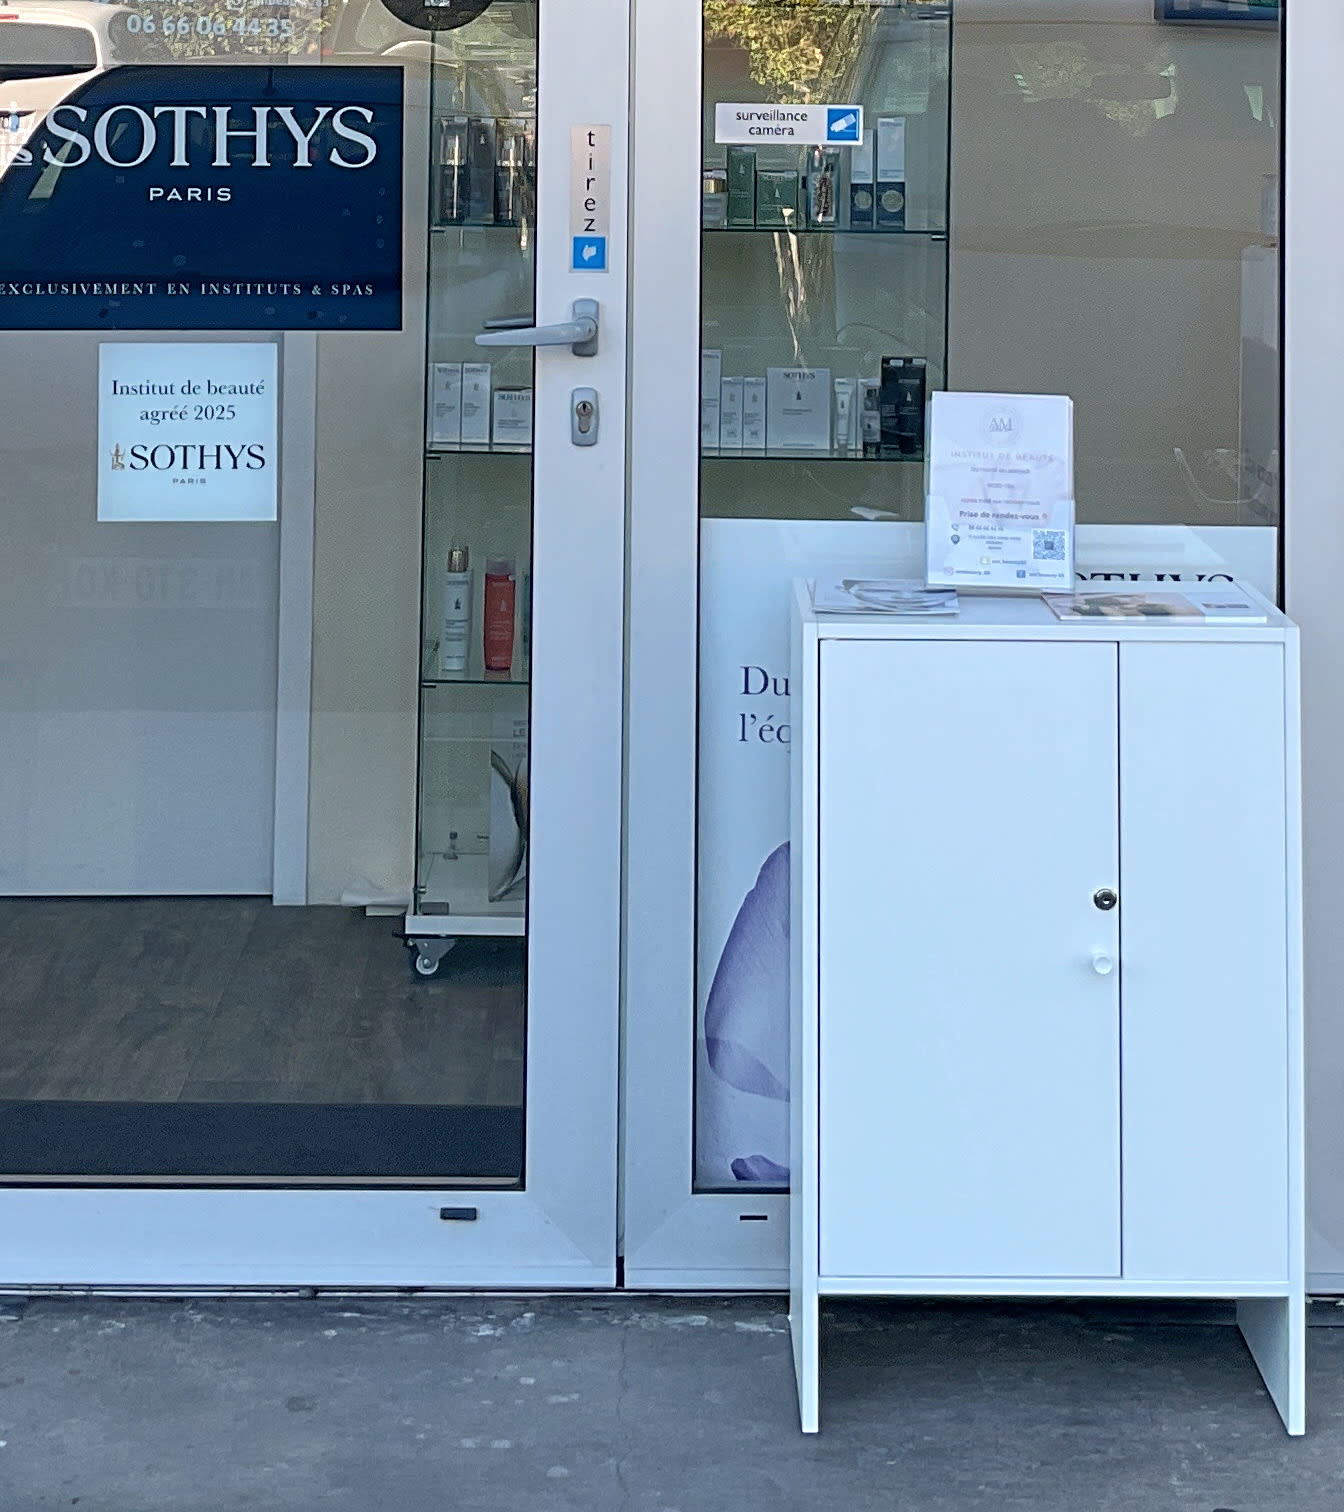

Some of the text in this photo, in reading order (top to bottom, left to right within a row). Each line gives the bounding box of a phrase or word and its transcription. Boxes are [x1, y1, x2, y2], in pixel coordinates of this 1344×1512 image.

[127, 15, 294, 39] 06 66 06 44 35
[736, 109, 808, 121] surveillance
[45, 104, 376, 168] SOTHYS
[584, 130, 596, 232] tirez
[150, 188, 231, 201] PARIS
[167, 283, 191, 295] EN
[201, 283, 302, 295] INSTITUTS
[312, 284, 322, 295] &
[331, 284, 374, 296] SPAS
[112, 379, 265, 395] Institut de beauté
[140, 405, 236, 425] agréé 2025
[129, 443, 266, 471] SOTHYS
[740, 666, 790, 696] Du
